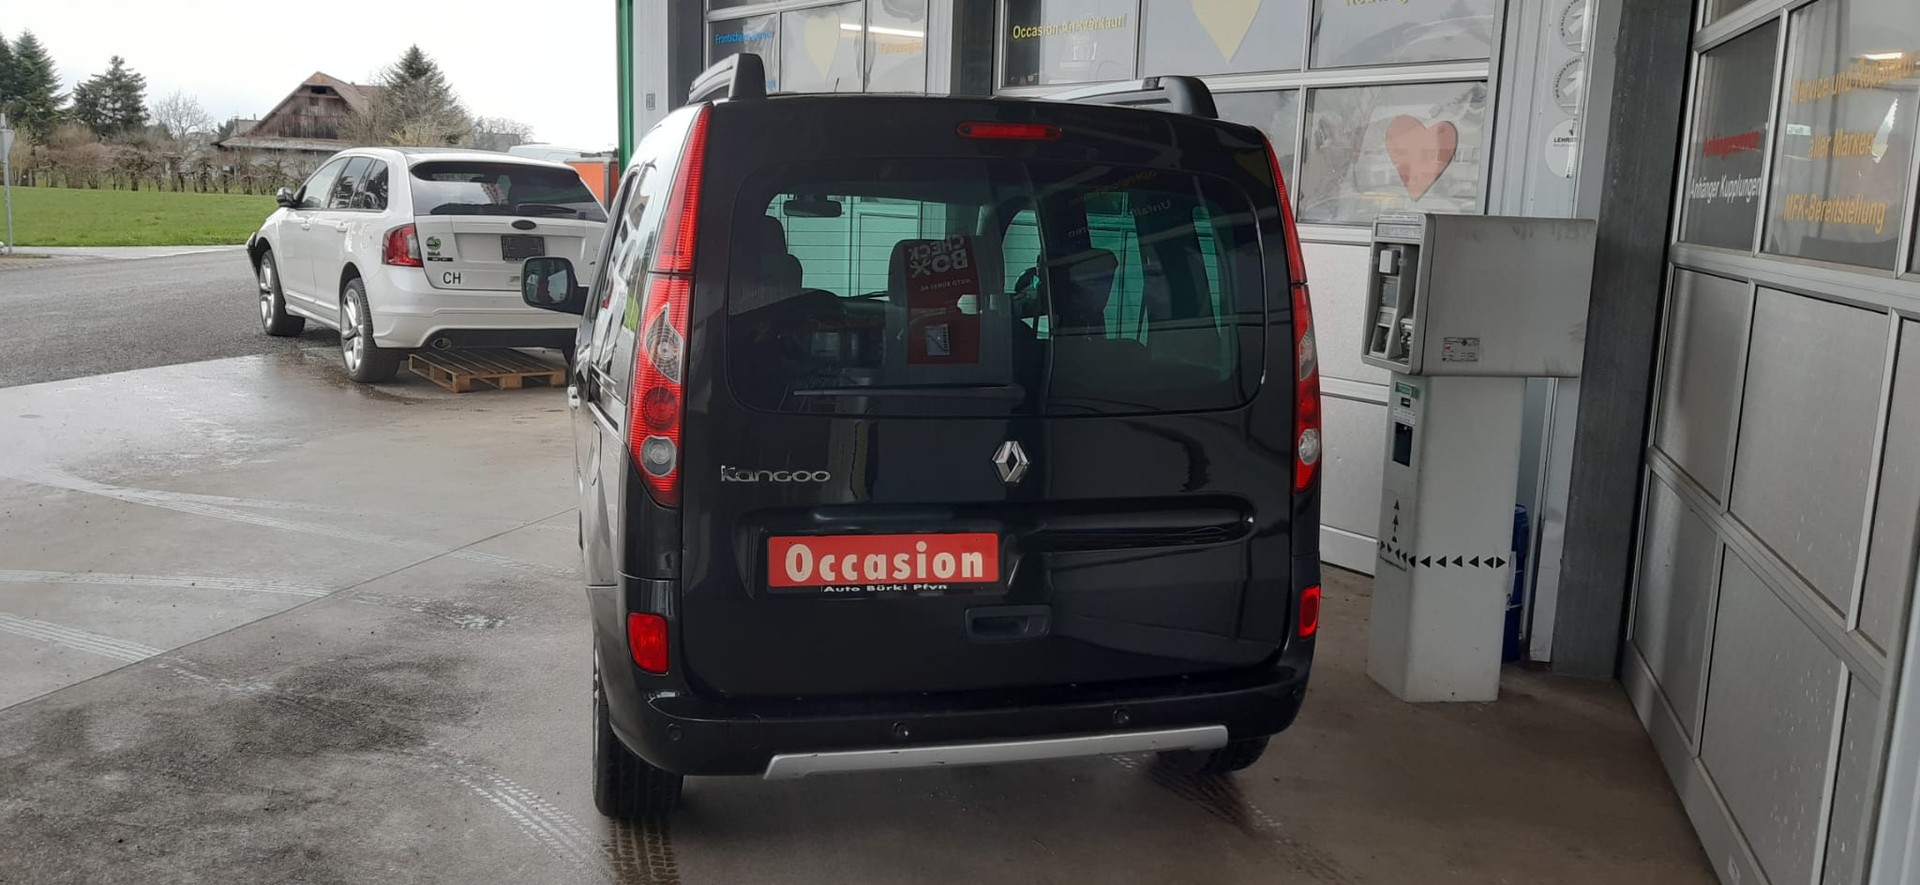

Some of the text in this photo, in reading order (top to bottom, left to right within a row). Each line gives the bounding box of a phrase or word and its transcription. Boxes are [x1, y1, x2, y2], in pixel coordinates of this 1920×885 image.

[1784, 193, 1888, 234] MFK-Bereitstellung
[442, 271, 461, 285] CH
[785, 541, 983, 582] Occasion
[823, 585, 860, 593] Auto
[866, 583, 907, 592] Bürki
